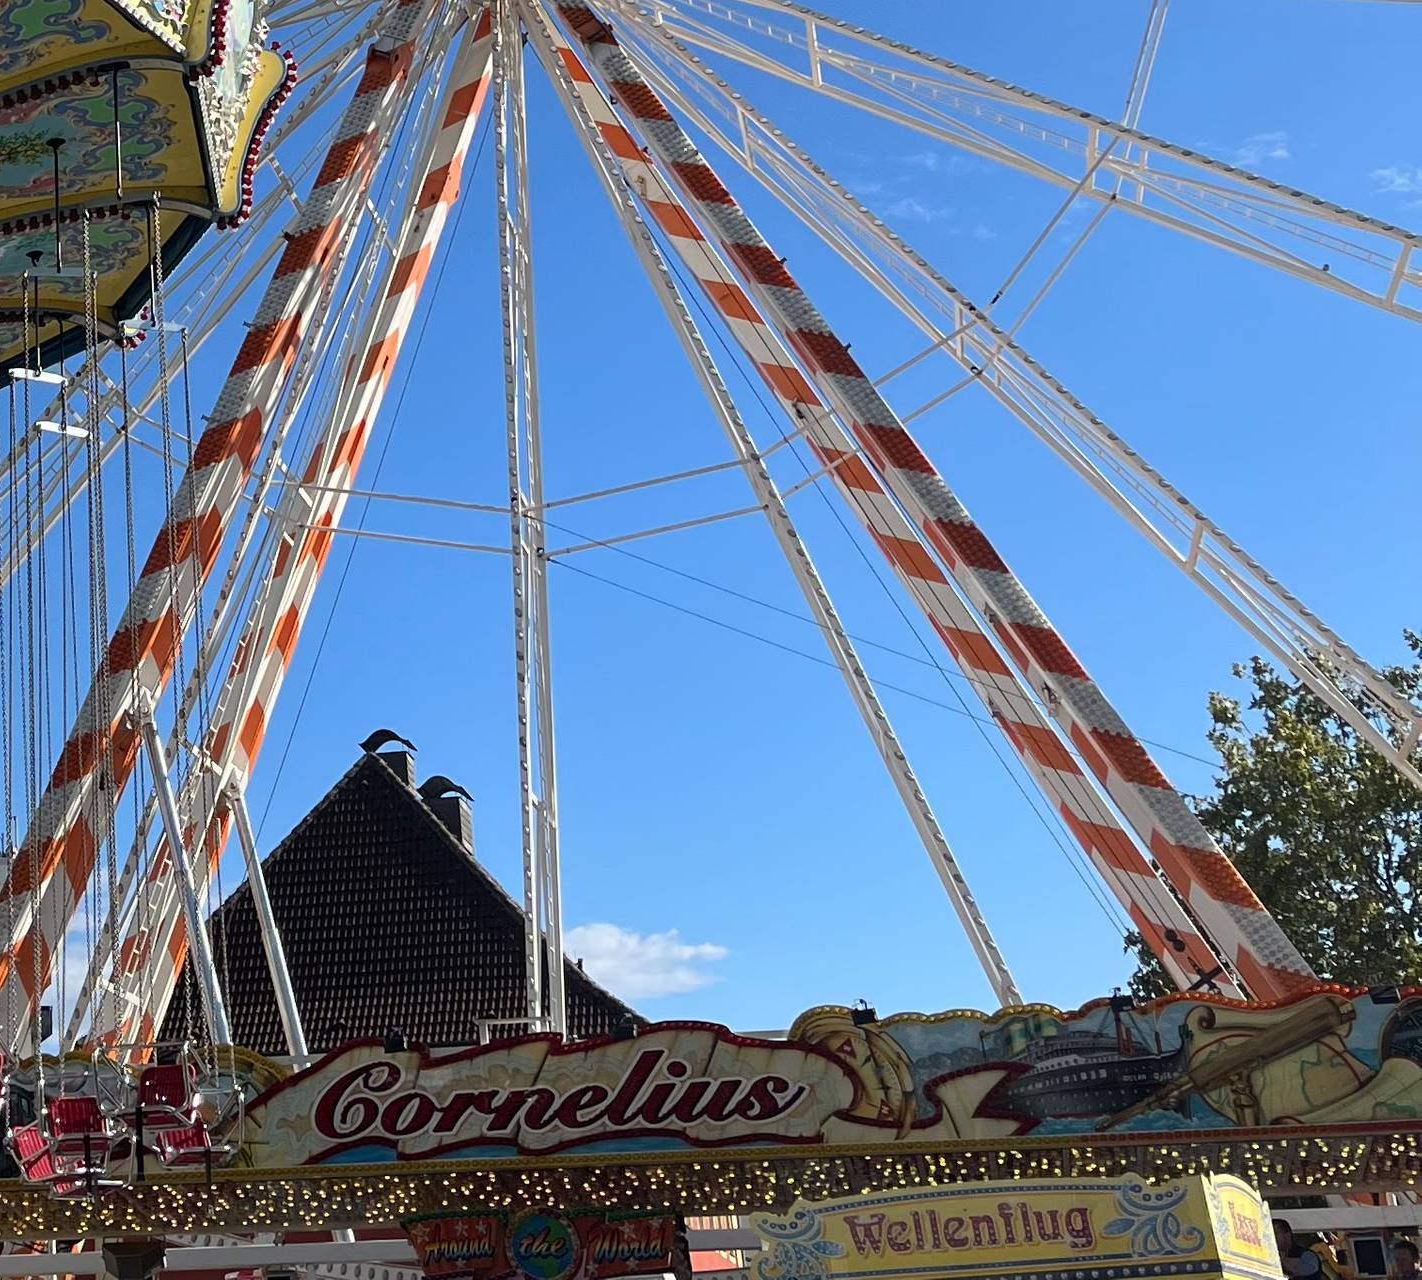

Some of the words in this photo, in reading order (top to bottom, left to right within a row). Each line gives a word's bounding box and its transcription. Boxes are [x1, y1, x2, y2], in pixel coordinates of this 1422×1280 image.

[315, 1048, 808, 1141] Cornelius
[424, 1226, 495, 1265] Around
[519, 1227, 566, 1260] the
[589, 1226, 667, 1265] World
[843, 1202, 1094, 1255] Wellenflug
